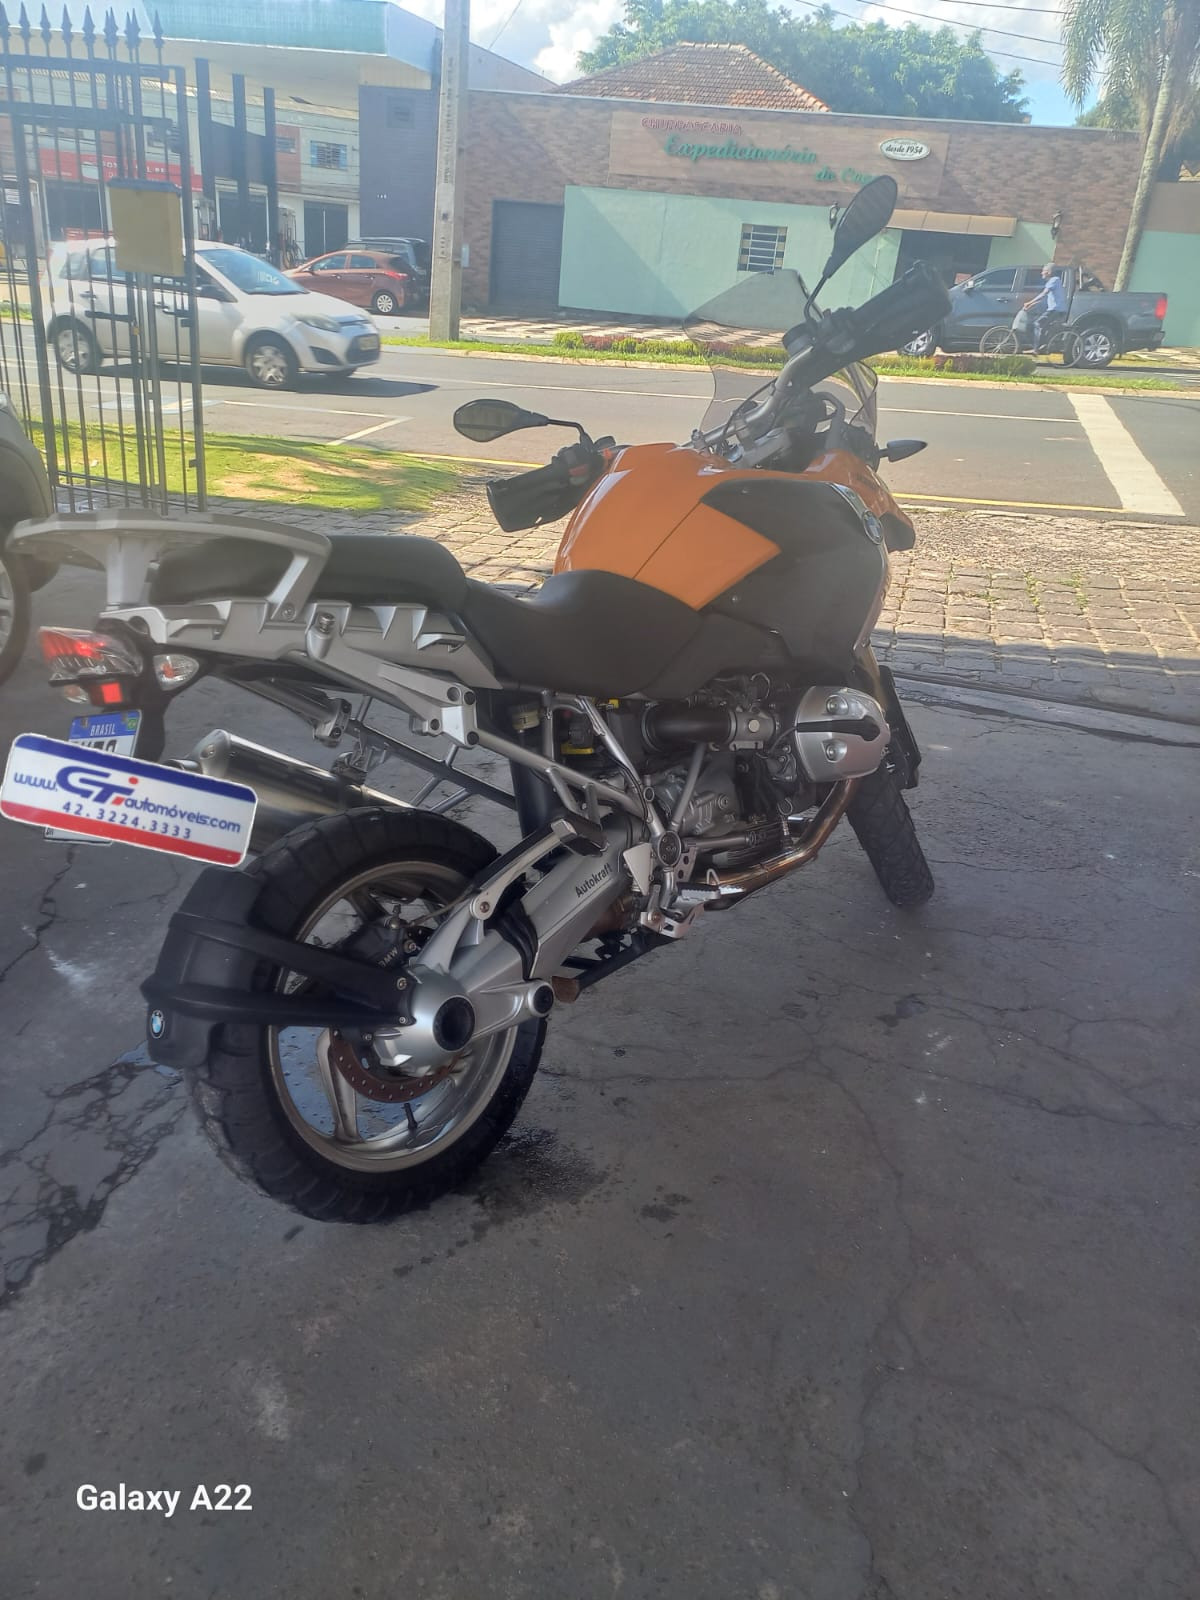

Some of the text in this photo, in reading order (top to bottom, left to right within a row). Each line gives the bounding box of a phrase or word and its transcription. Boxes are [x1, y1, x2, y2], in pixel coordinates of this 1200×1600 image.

[90, 723, 116, 736] BRASIL
[62, 801, 192, 839] 42.3224.3333
[575, 863, 613, 898] Autokraft
